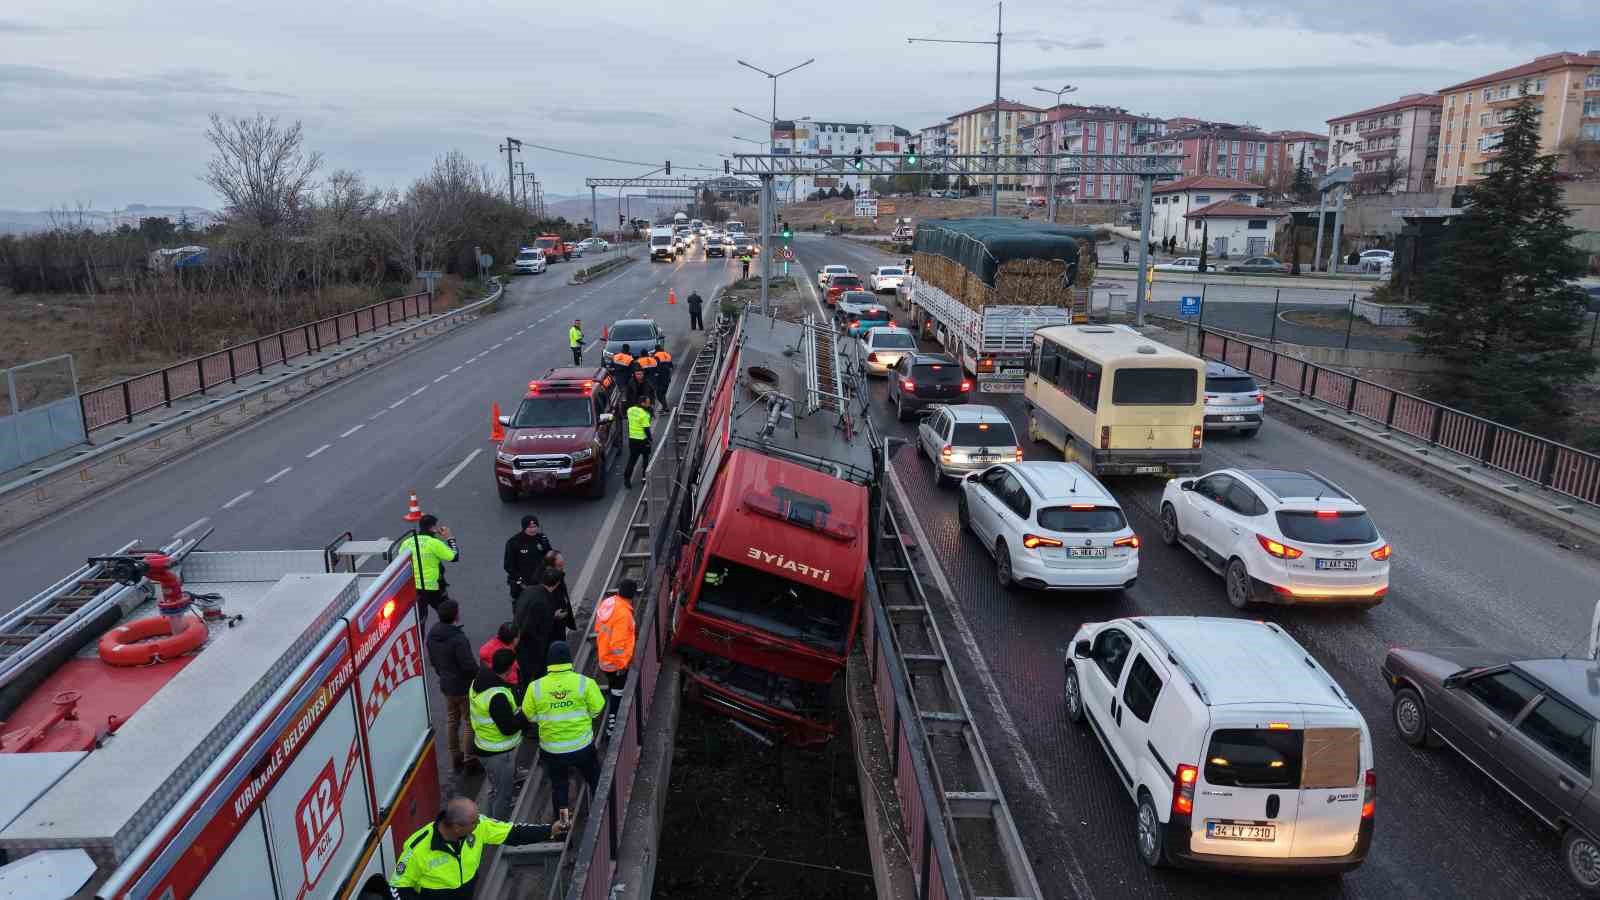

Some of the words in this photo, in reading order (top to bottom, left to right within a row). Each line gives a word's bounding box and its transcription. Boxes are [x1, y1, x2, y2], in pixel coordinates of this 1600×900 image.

[234, 747, 283, 818] KIRIKKALE
[303, 778, 335, 850] 112
[1215, 826, 1227, 836] 34
[1231, 826, 1244, 837] LV
[1248, 827, 1271, 839] 7310
